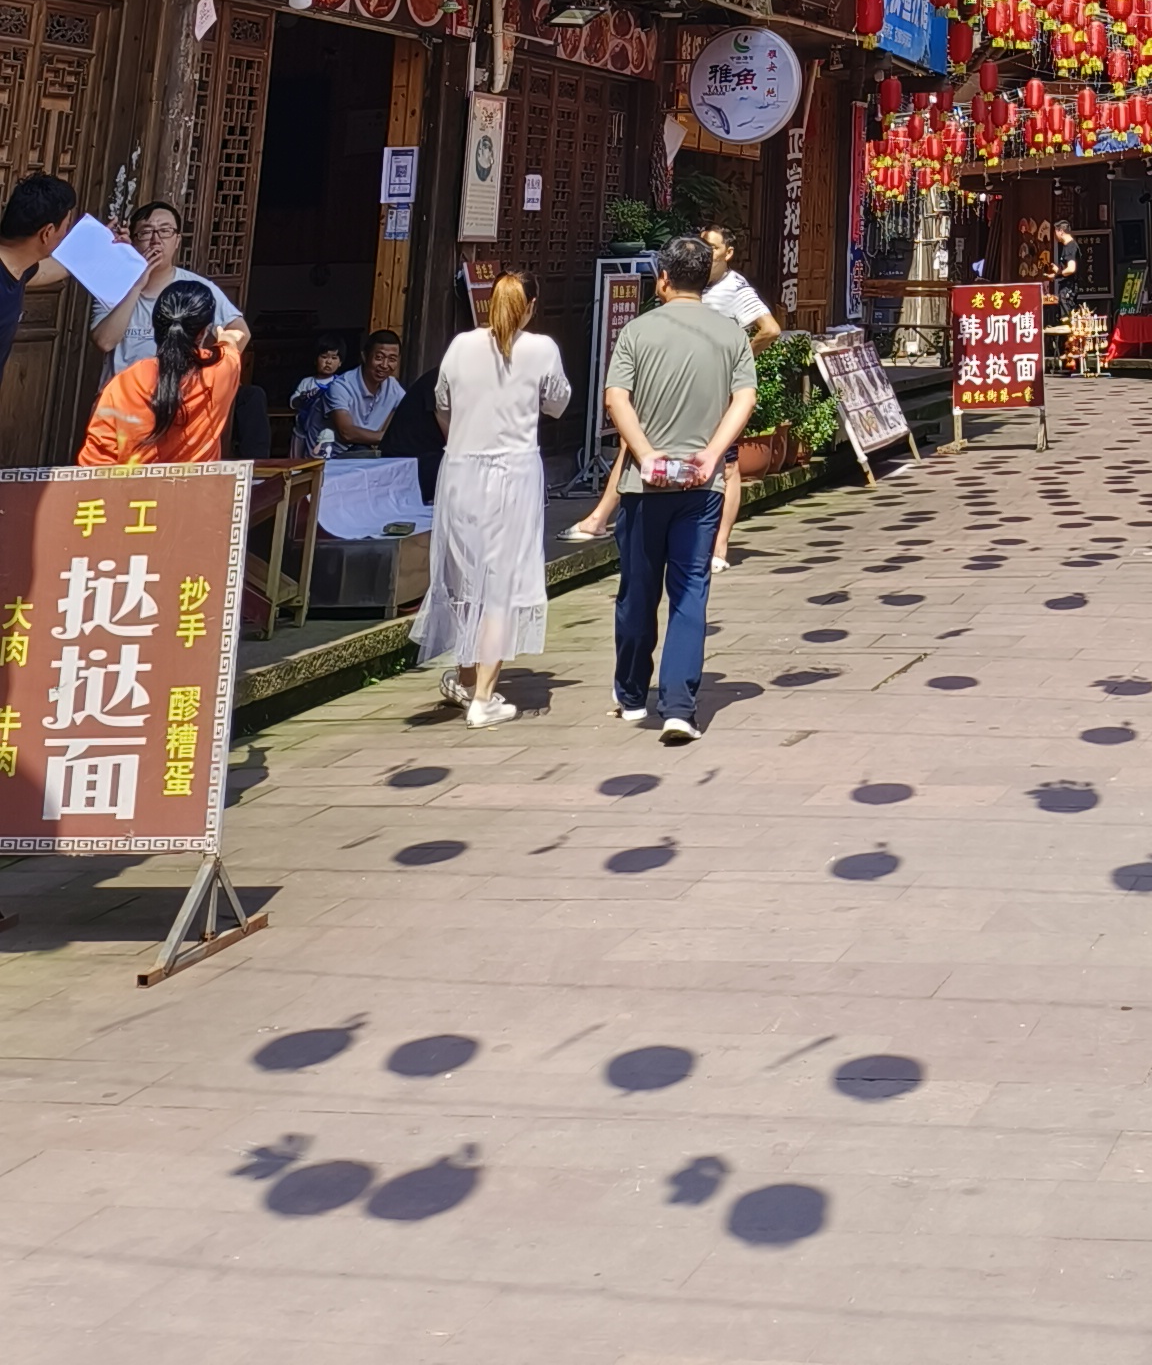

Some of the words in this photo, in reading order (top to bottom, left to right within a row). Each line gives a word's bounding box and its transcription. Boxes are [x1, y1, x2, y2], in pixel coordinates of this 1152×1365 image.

[706, 84, 731, 93] YAYU
[708, 63, 758, 92] 雅鱼
[971, 289, 1023, 309] 老字号
[957, 310, 1039, 347] 韩师傅
[957, 351, 1040, 386] 挞挞面
[73, 498, 159, 538] 手工
[175, 575, 212, 649] 抄手
[0, 596, 34, 668] 大肉
[42, 553, 161, 822] 挞挞面
[161, 685, 202, 798] 醪糟蛋
